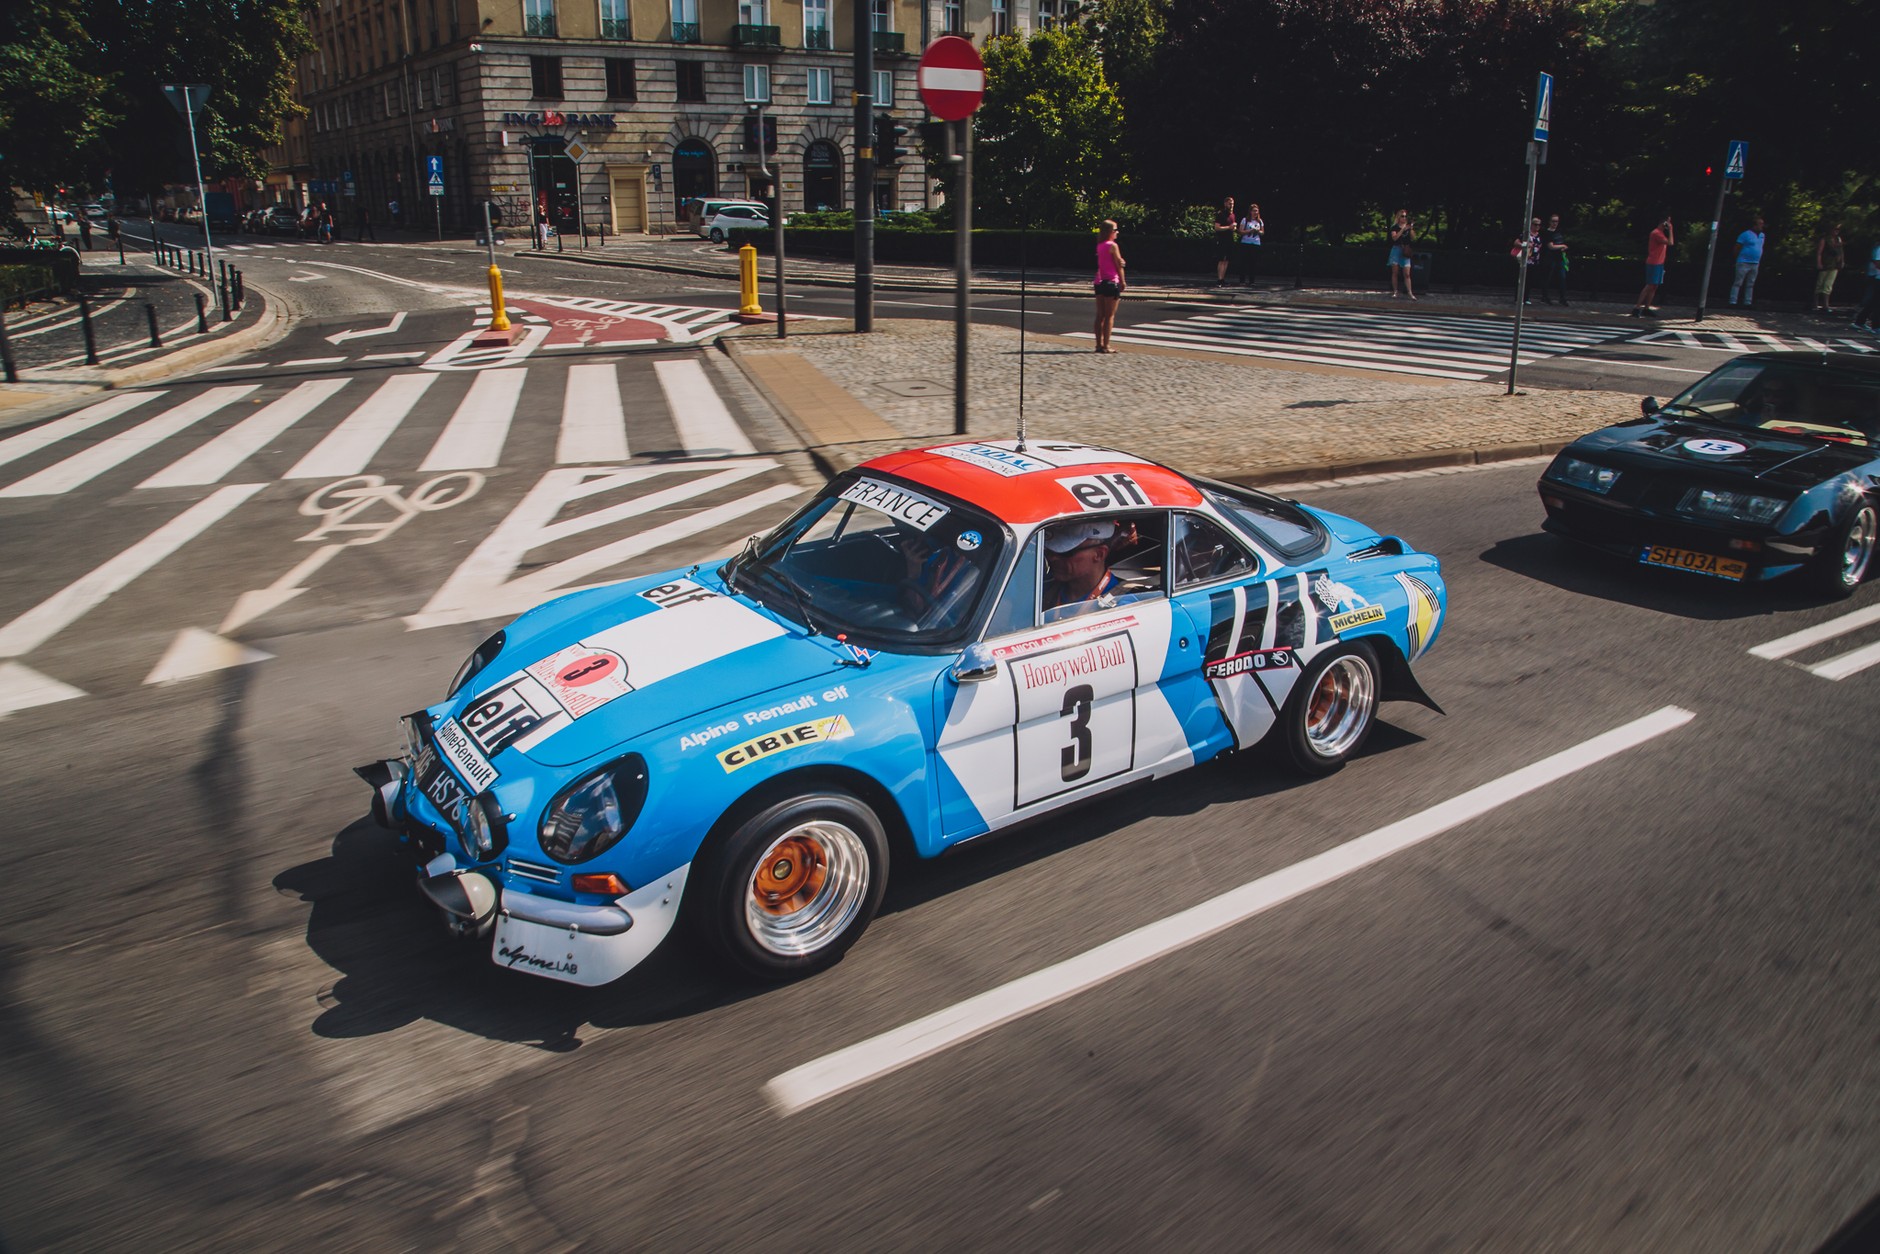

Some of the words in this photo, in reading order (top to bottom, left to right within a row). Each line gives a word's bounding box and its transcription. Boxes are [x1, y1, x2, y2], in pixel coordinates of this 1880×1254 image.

[504, 112, 540, 127] ING
[566, 113, 618, 128] BANK
[1701, 442, 1732, 451] 13
[844, 480, 943, 526] FRANCE
[1071, 473, 1146, 508] elf
[1652, 547, 1680, 564] SH
[1683, 552, 1717, 571] 03A
[642, 584, 718, 609] elf
[1332, 607, 1383, 629] MICHELIN
[994, 649, 1006, 660] JP
[1010, 637, 1054, 655] NICOLAS
[563, 658, 610, 681] 3
[1022, 648, 1098, 689] Honeywell
[1096, 639, 1126, 670] Bull
[1206, 653, 1266, 678] FERODO
[559, 685, 611, 717] MAROC
[466, 701, 540, 749] elf
[679, 719, 740, 751] Alpine
[743, 694, 819, 726] Renault
[822, 685, 849, 703] elf
[1060, 683, 1094, 782] 3
[427, 770, 456, 804] HS
